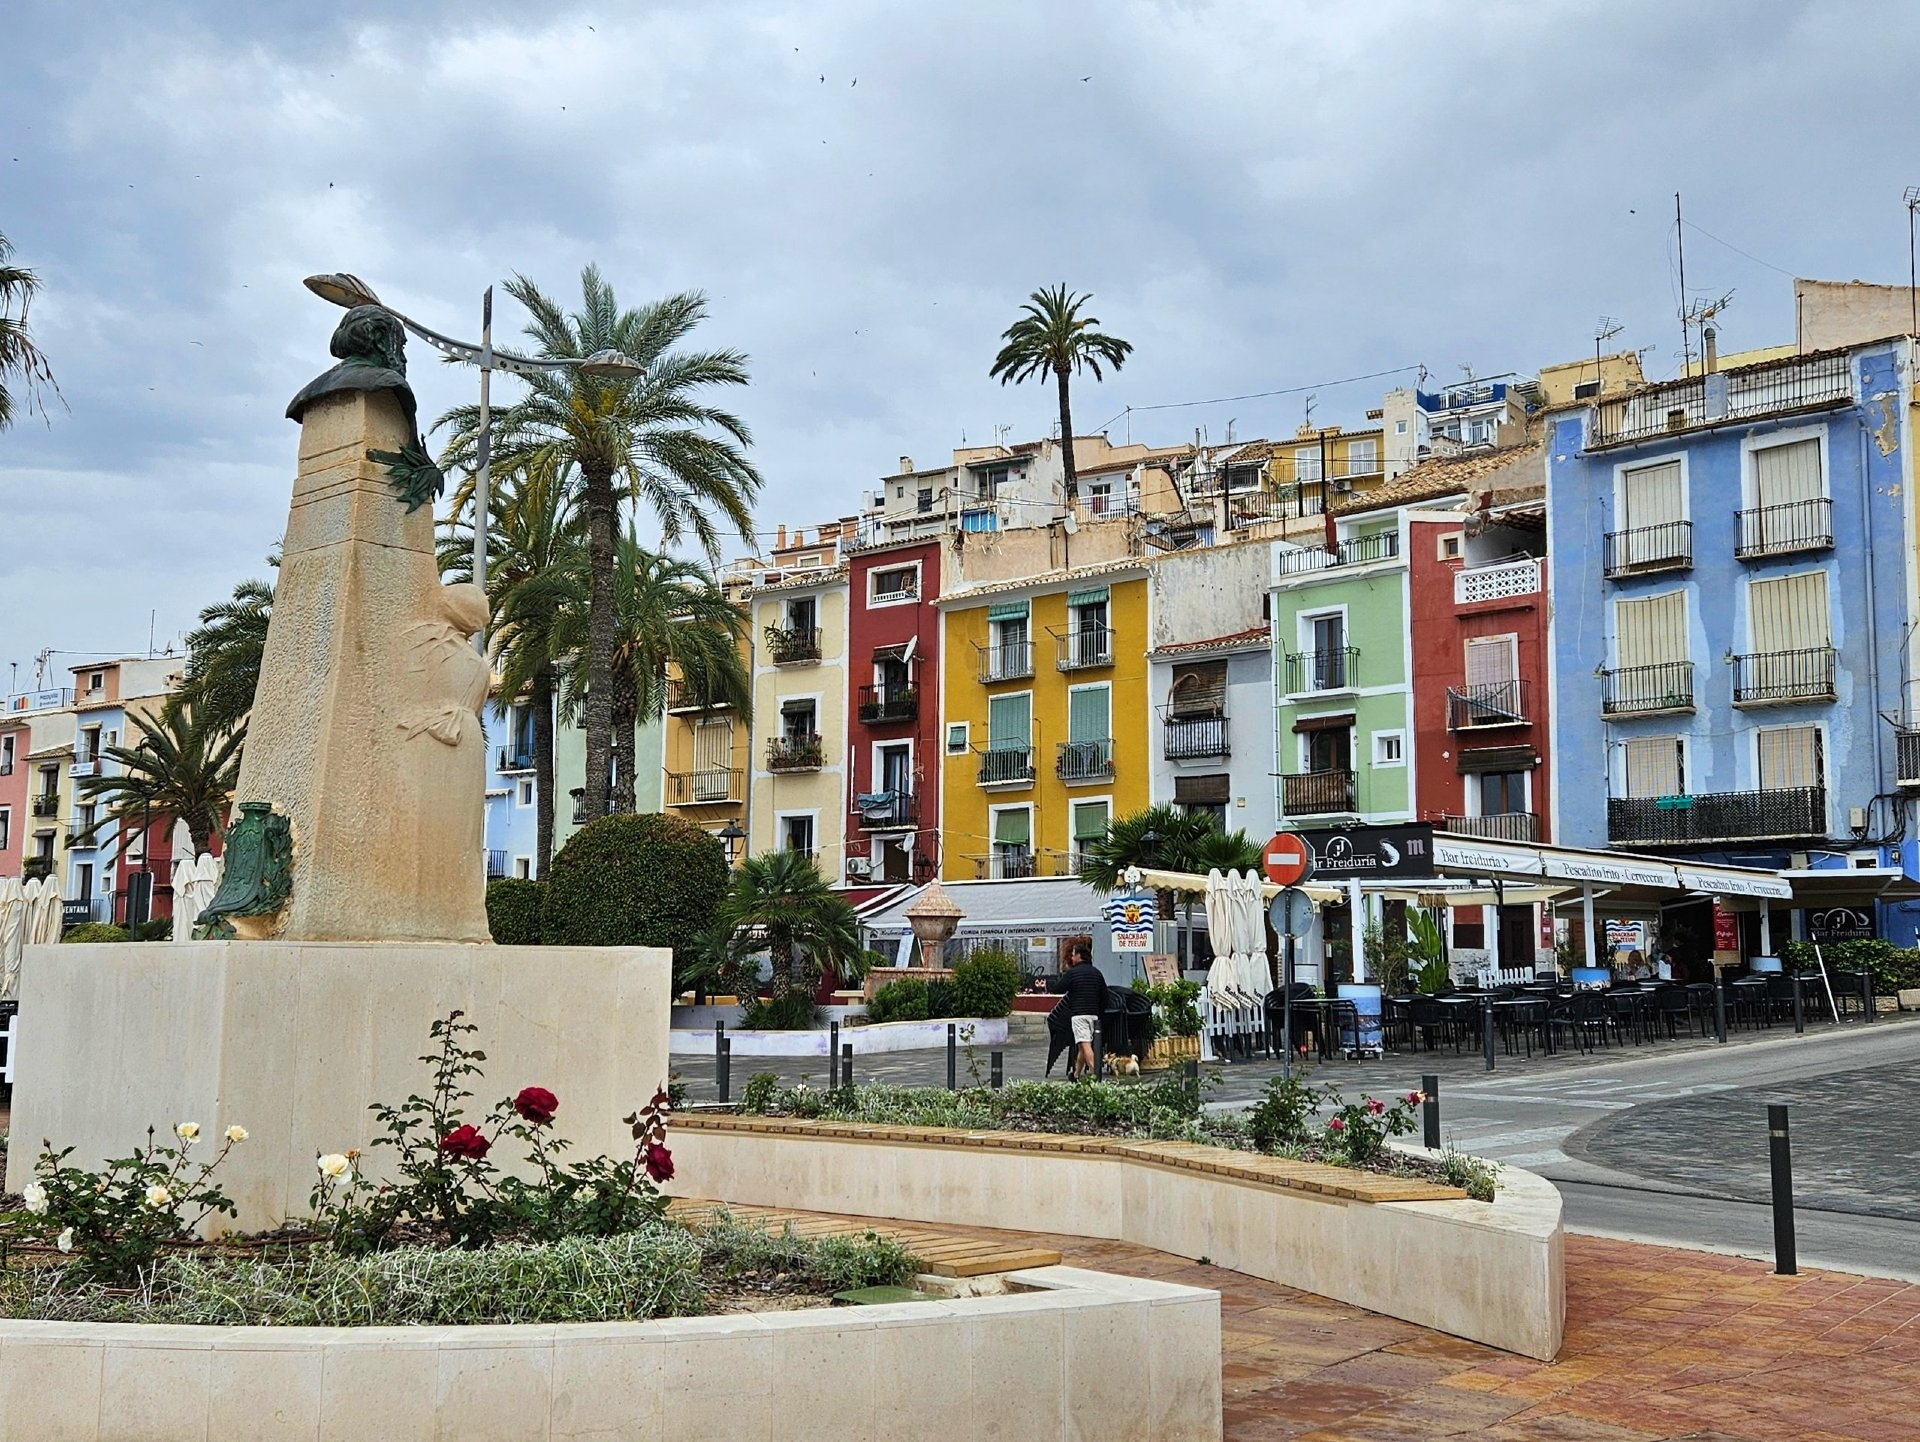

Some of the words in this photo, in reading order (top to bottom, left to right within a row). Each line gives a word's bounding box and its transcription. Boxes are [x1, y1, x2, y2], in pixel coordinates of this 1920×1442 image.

[1440, 848, 1459, 864] Bar
[1562, 862, 1602, 878] Pescadito
[1117, 933, 1148, 941] SNACKBAR
[1127, 940, 1147, 948] ZEEUW
